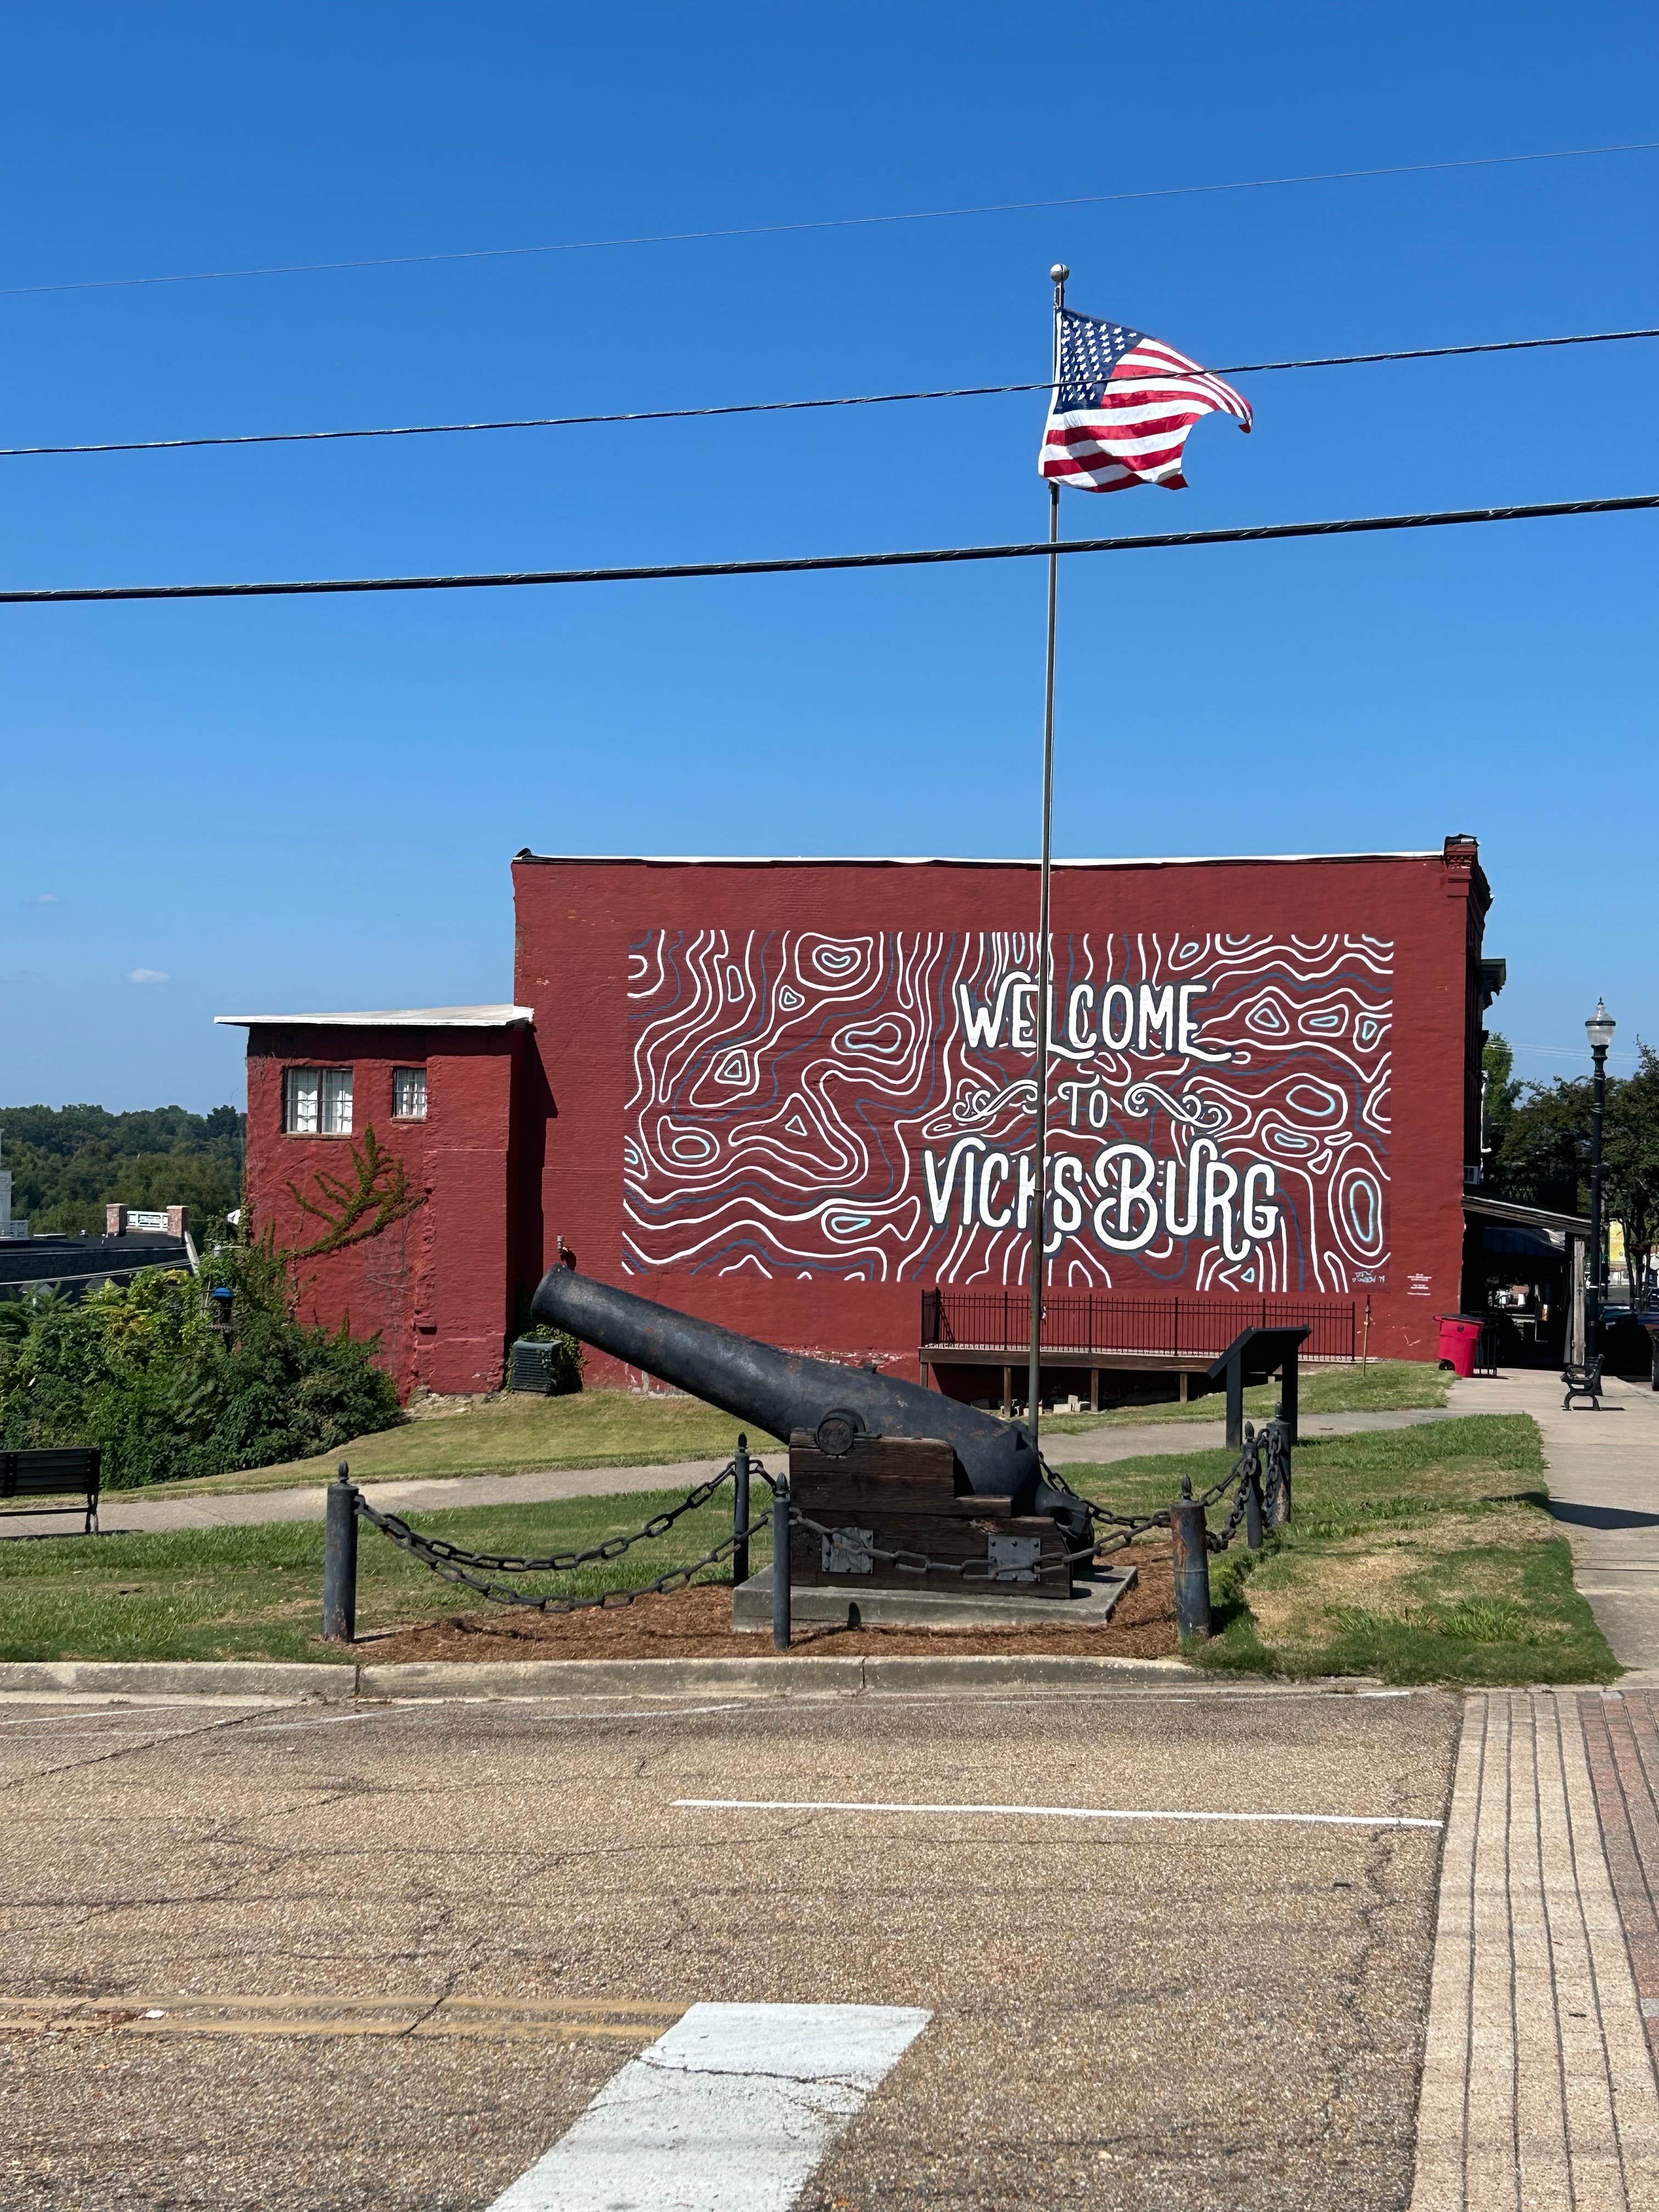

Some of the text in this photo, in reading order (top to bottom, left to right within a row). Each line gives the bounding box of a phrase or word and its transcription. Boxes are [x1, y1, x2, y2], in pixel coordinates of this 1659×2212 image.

[960, 972, 1232, 1062] WELCOME
[1058, 1074, 1108, 1127] TO
[925, 1137, 1279, 1261] VICKSBURG
